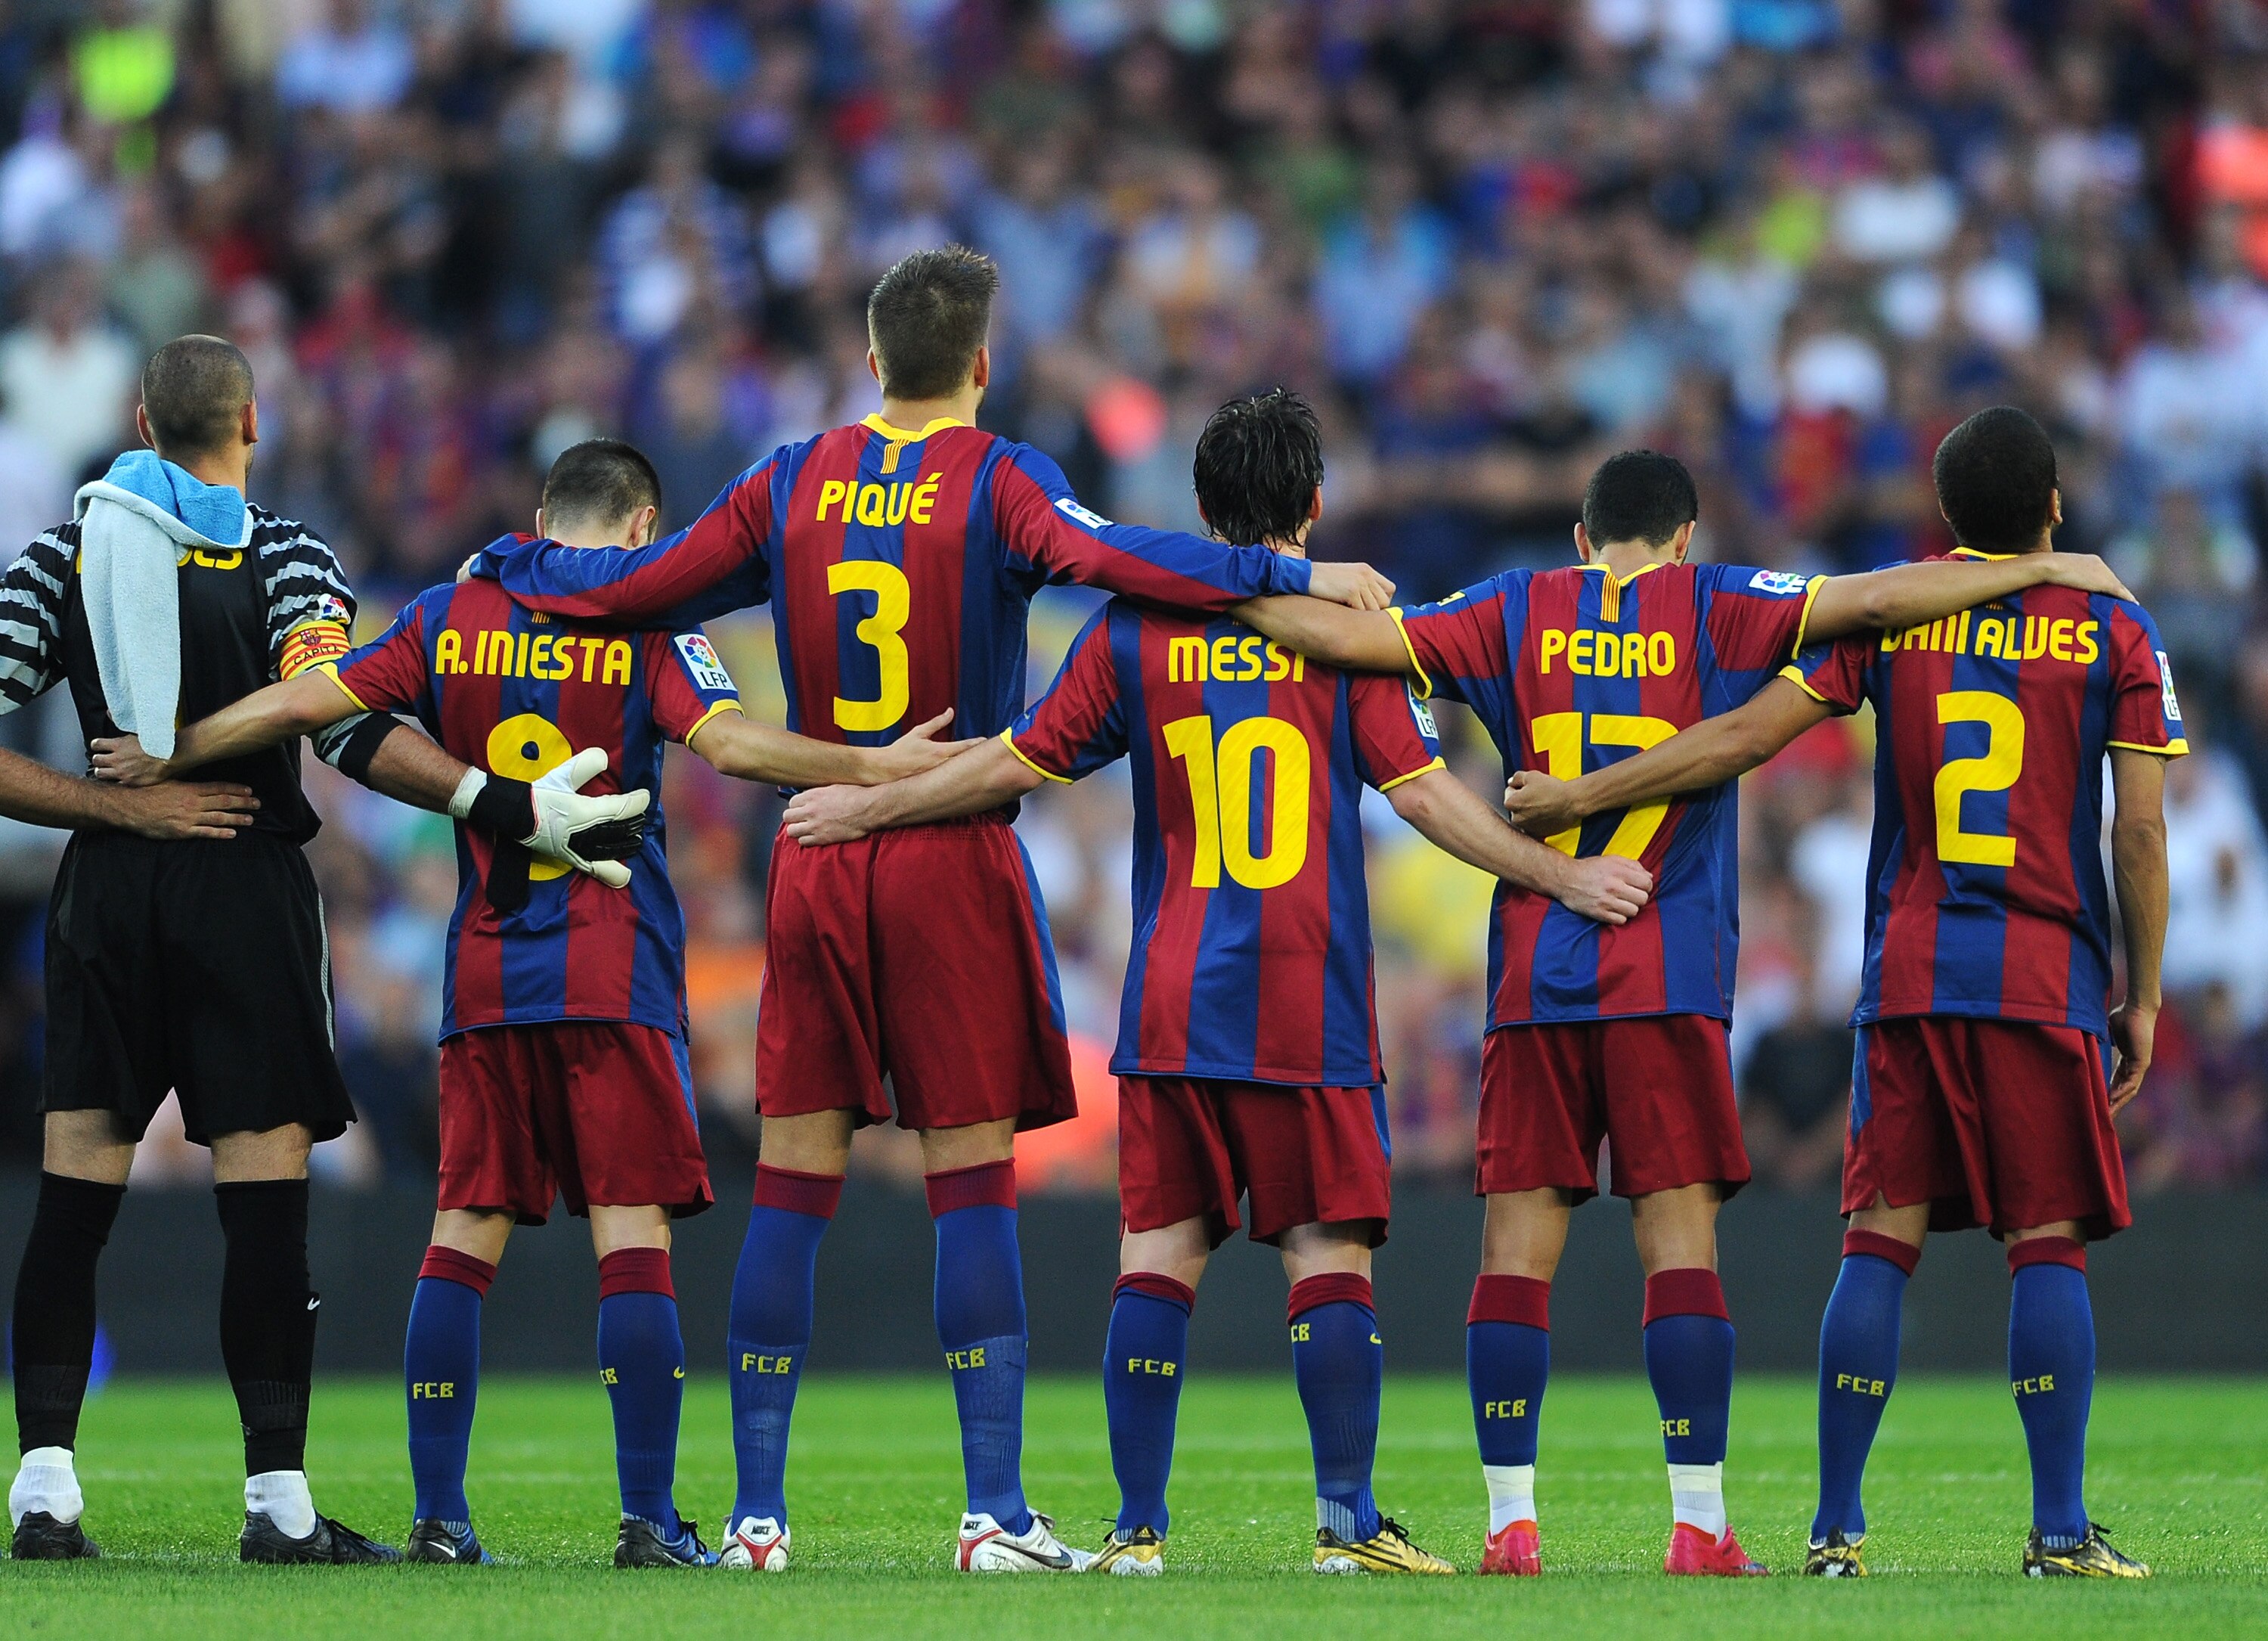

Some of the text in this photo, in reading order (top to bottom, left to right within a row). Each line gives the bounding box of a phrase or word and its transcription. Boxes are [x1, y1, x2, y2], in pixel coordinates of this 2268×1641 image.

[816, 473, 943, 528] PIQUÉ
[827, 560, 910, 731] 3
[1541, 629, 1676, 678] PEDRO
[1974, 615, 2099, 664] ALVES
[1168, 636, 1305, 683] MESSI
[699, 671, 728, 688] LFP
[1531, 712, 1679, 861] 17
[1934, 690, 2025, 867] 2
[1162, 715, 1311, 889] 10
[742, 1352, 792, 1375] FCB
[945, 1347, 986, 1370] FCB
[1128, 1357, 1176, 1377] FCB
[413, 1382, 454, 1400] FCB
[1836, 1373, 1885, 1397] FCB
[2012, 1375, 2055, 1397] FCB
[1486, 1398, 1526, 1419] FCB
